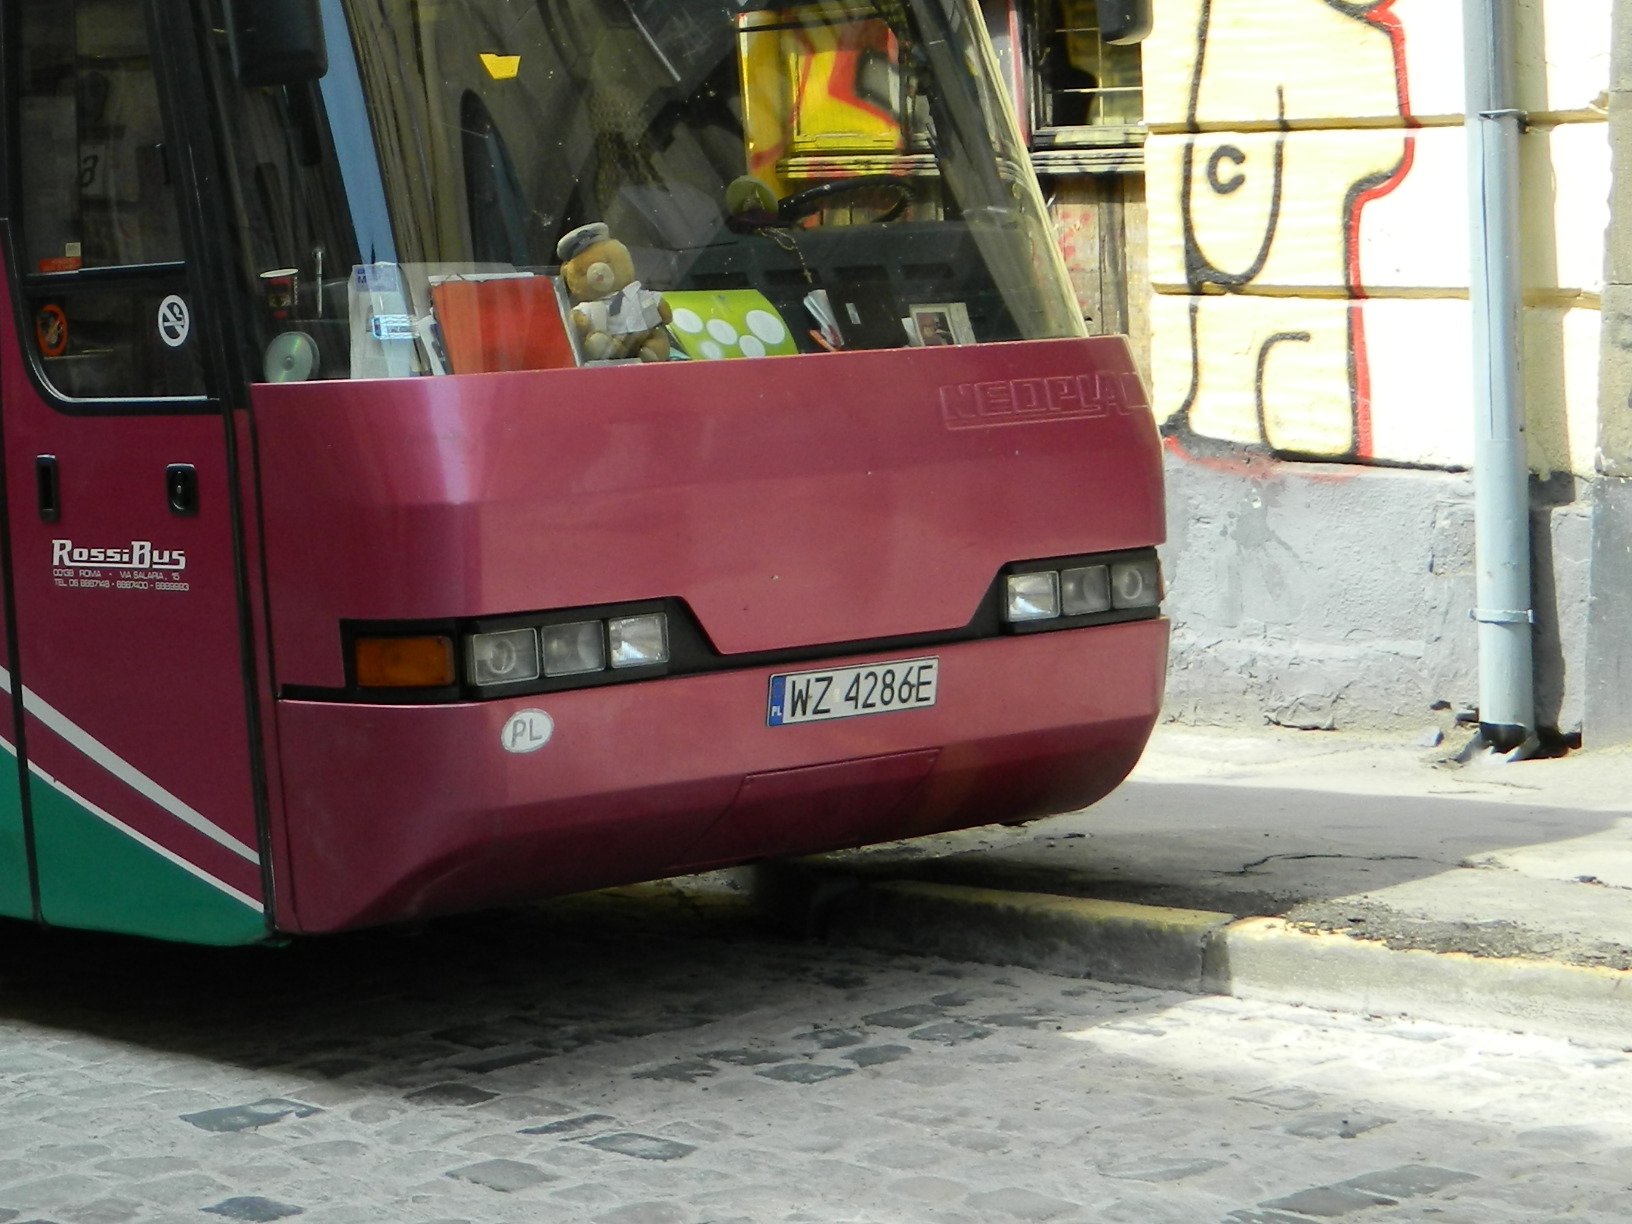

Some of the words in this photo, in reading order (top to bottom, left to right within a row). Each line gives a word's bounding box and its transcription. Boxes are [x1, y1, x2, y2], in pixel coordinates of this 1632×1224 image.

[78, 569, 102, 579] ROMA
[119, 570, 132, 580] VIA
[790, 675, 834, 717] WZ
[844, 663, 934, 710] 4286E
[771, 706, 783, 717] PL
[509, 718, 543, 748] PL
